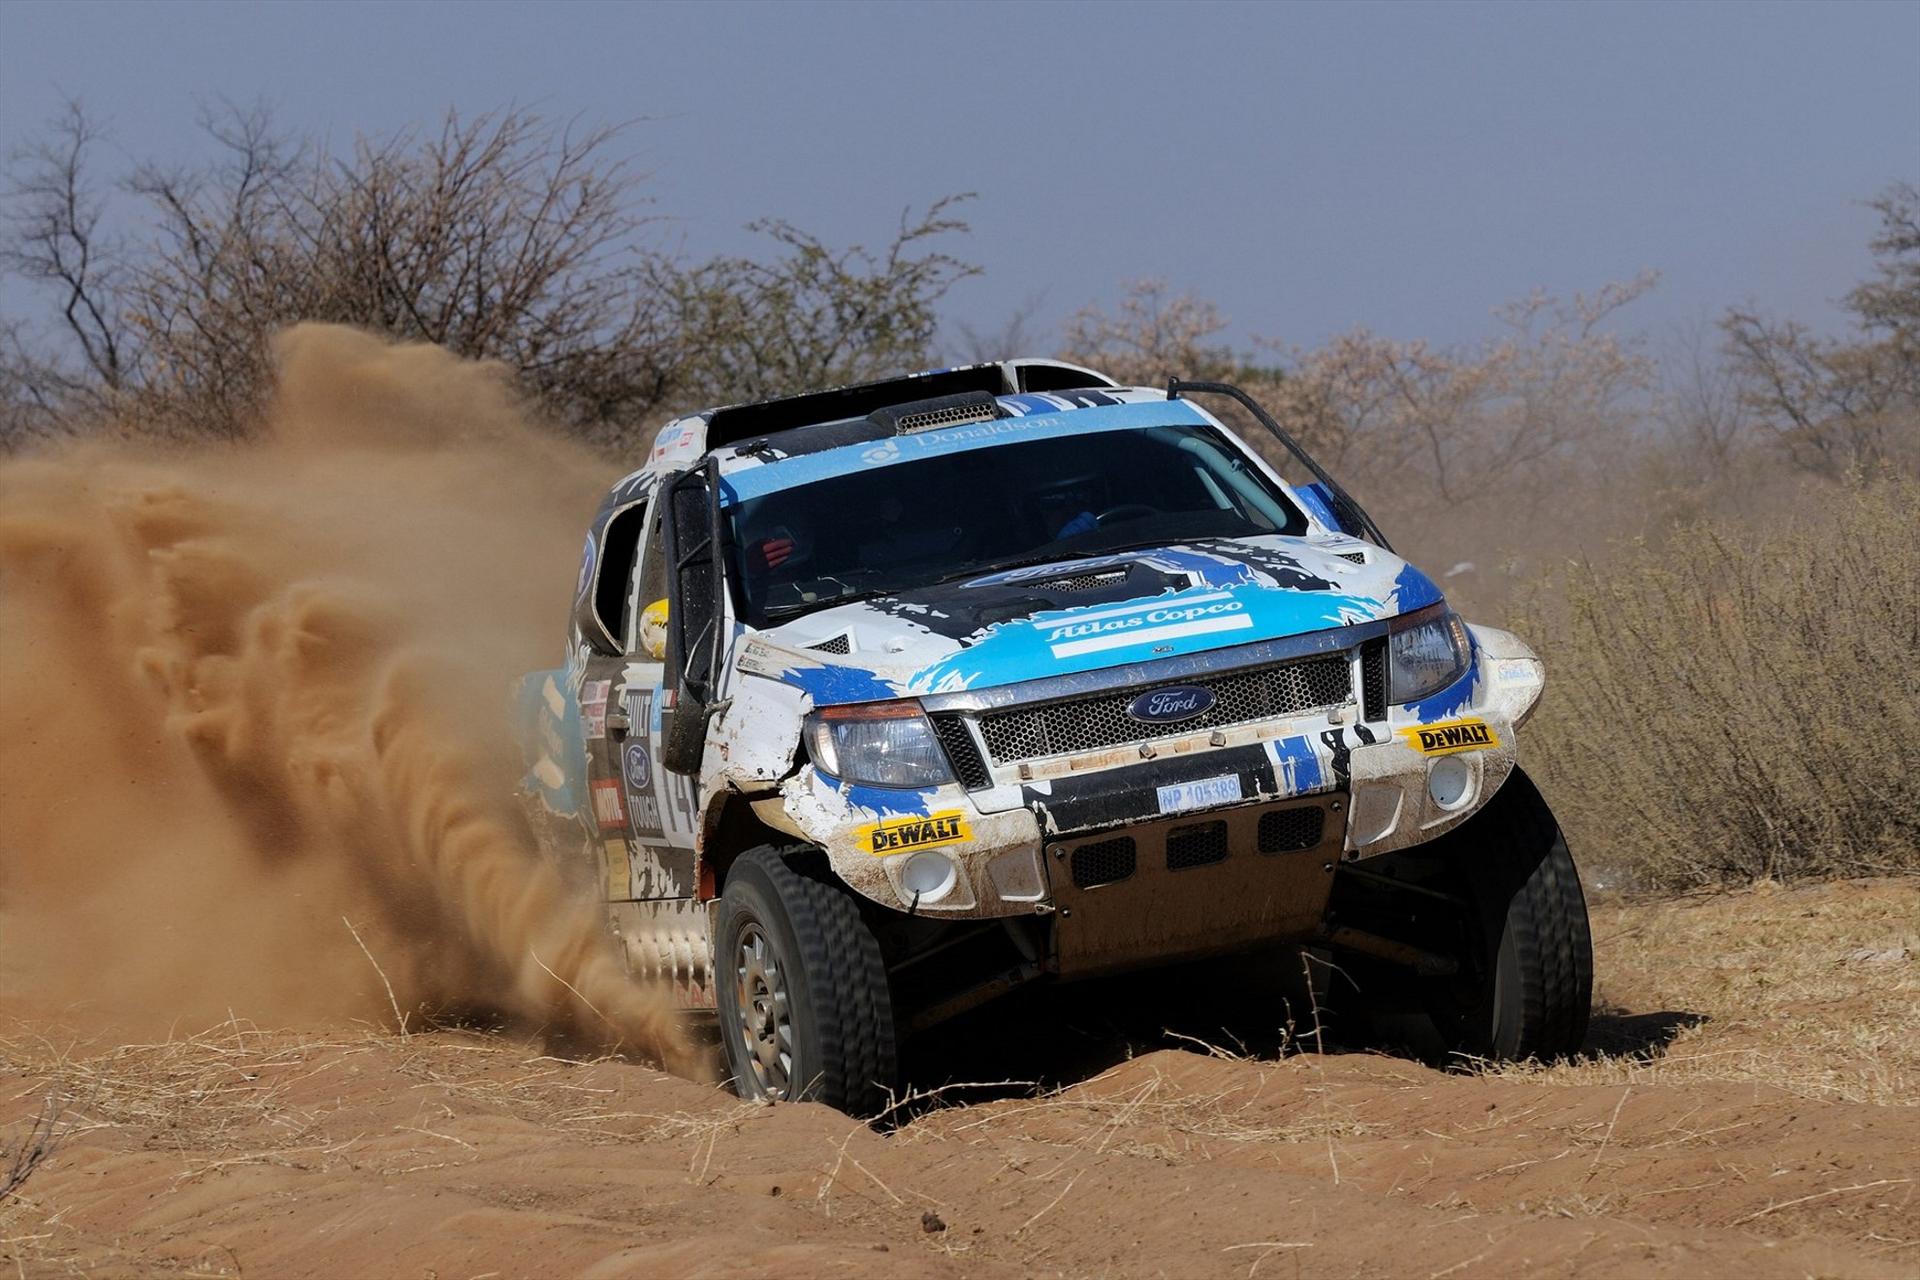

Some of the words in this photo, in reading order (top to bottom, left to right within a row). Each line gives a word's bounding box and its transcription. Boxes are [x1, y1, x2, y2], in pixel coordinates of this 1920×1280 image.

[914, 417, 1060, 446] Donaldson
[1045, 615, 1143, 641] Atlas
[1146, 601, 1243, 623] Copco
[1149, 690, 1198, 716] Ford
[630, 794, 661, 830] TOUGH
[1162, 788, 1182, 808] NP
